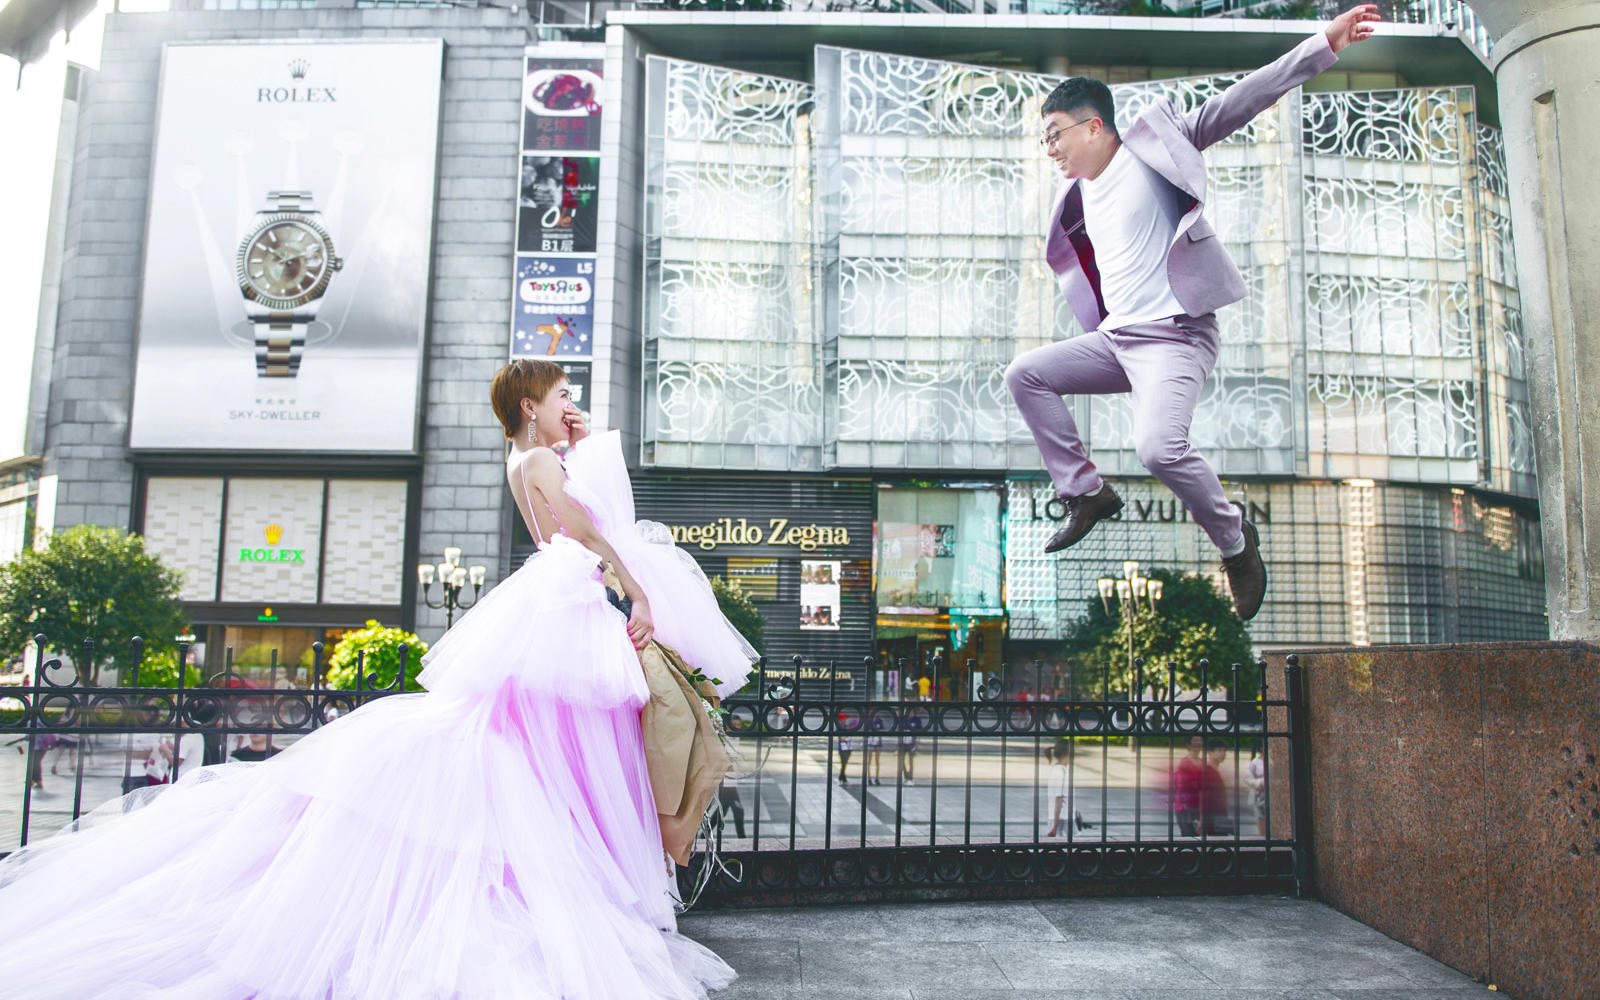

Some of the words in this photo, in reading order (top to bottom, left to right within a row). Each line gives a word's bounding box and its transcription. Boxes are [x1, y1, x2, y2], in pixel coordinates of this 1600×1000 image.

[257, 87, 336, 102] ROLEX
[577, 262, 593, 274] L5
[229, 410, 321, 421] SKY-DWELLER
[671, 518, 763, 550] negildo
[767, 518, 850, 551] Zegna
[240, 548, 305, 562] ROLEX
